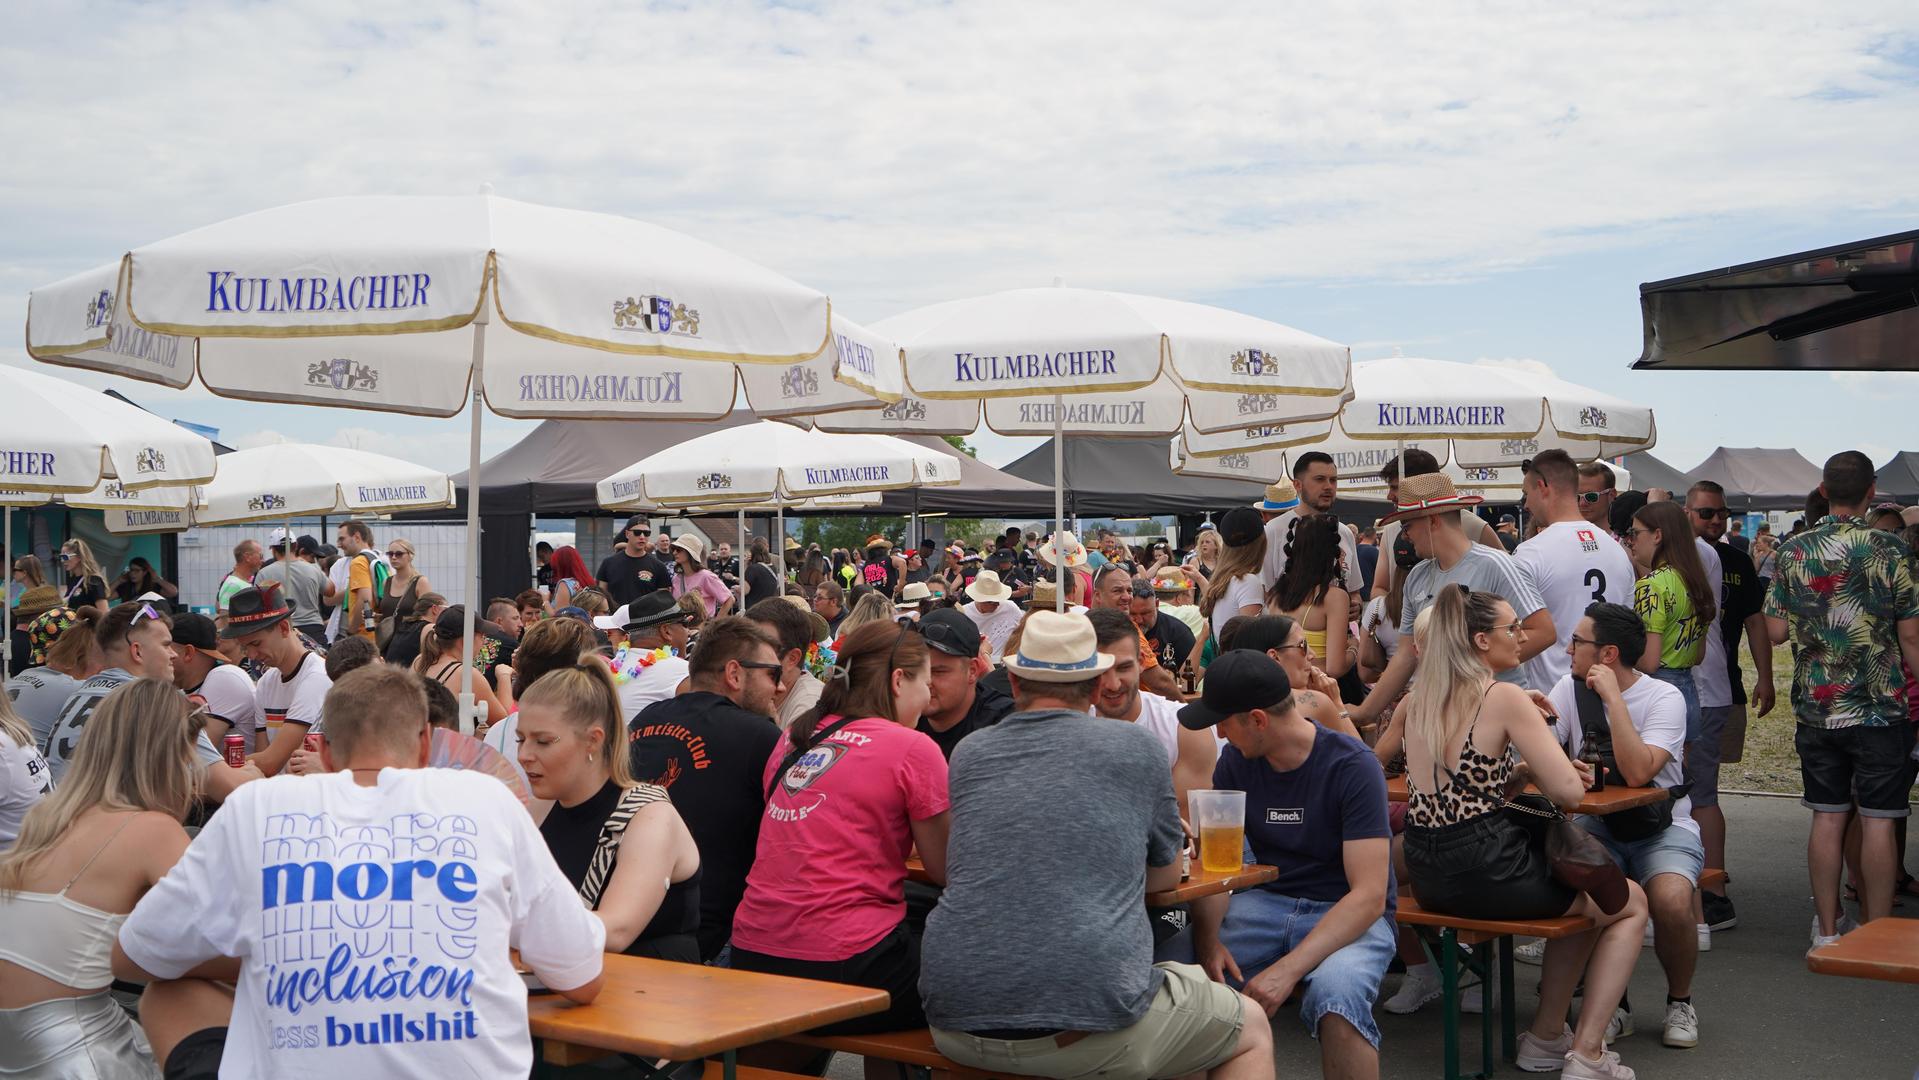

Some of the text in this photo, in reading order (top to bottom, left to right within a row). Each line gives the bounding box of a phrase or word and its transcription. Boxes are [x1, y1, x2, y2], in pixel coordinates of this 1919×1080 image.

[206, 271, 431, 313] KULMBACHER
[954, 350, 1118, 382] KULMBACHER
[1378, 403, 1506, 426] KULMBACHER
[805, 465, 889, 485] KULMBACHER
[358, 485, 427, 503] KULMBACHER
[1583, 568, 1607, 603] 3
[262, 858, 478, 911] more
[266, 942, 475, 1016] inclusion
[268, 1010, 479, 1050] less bullshit
